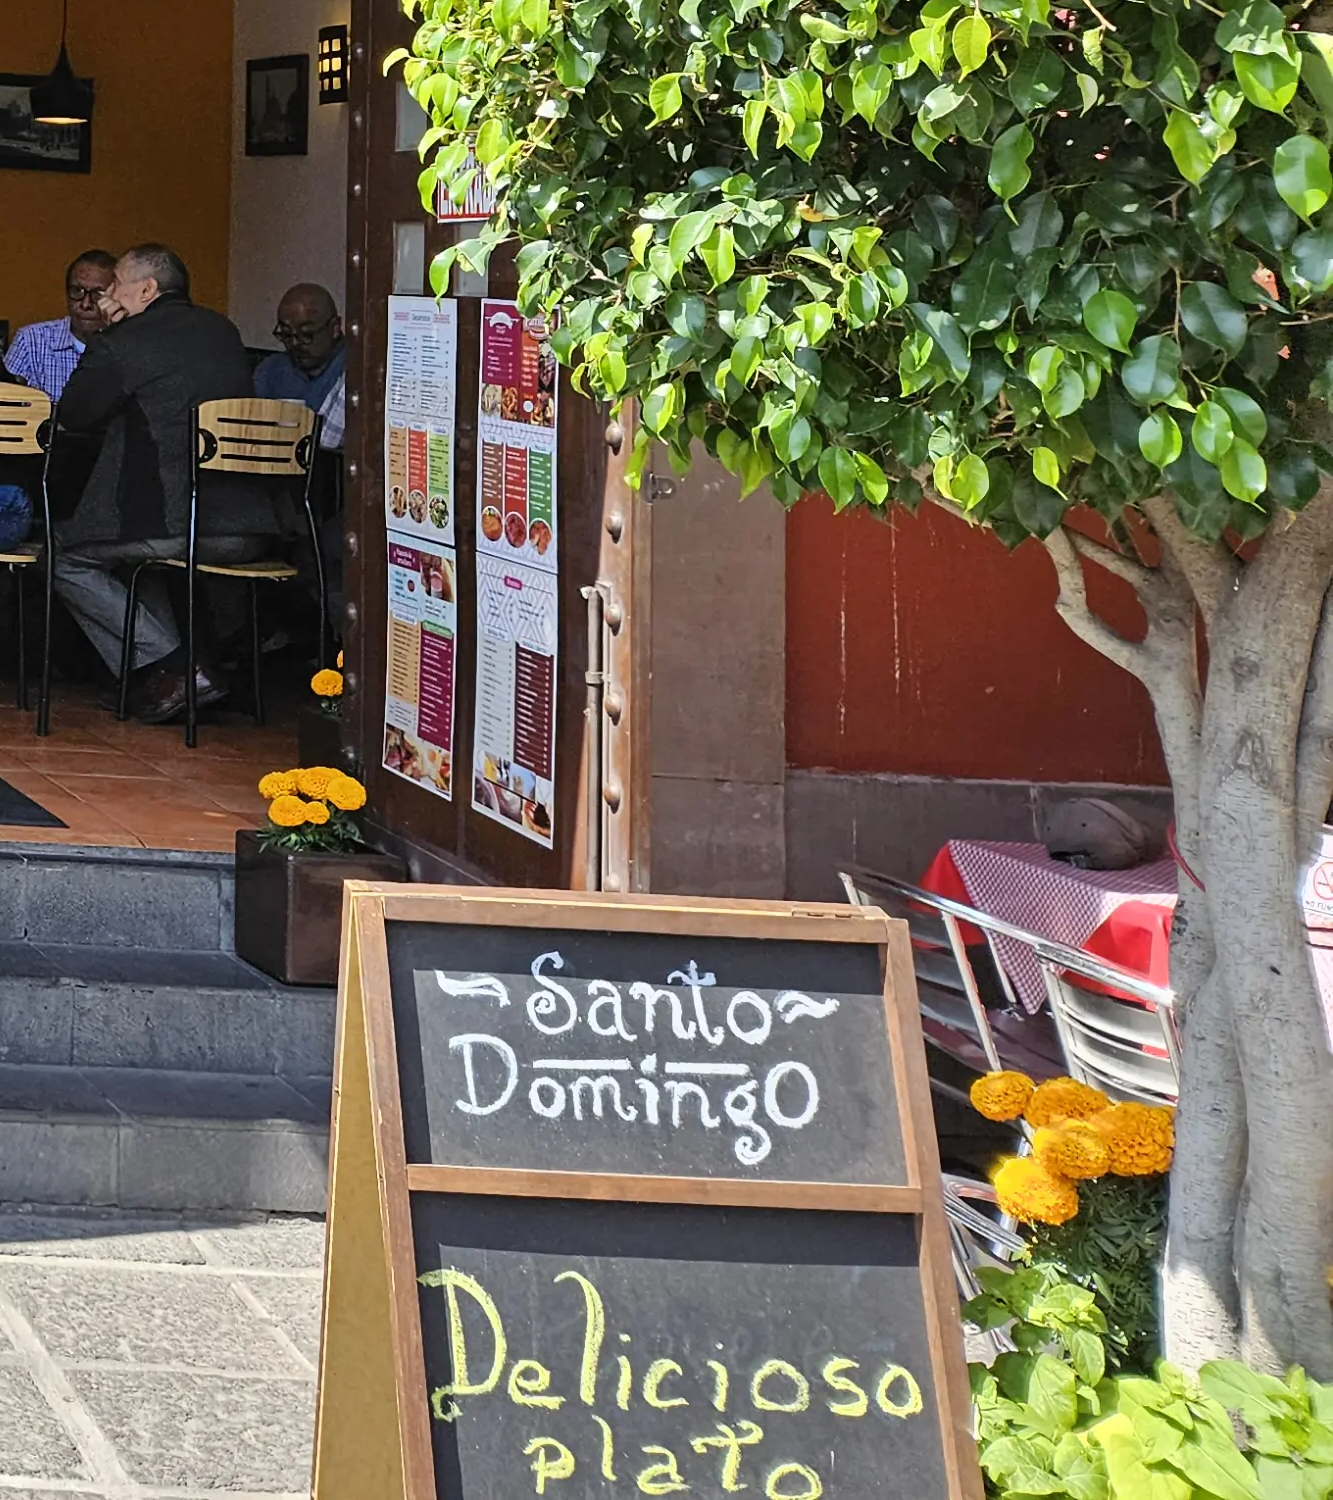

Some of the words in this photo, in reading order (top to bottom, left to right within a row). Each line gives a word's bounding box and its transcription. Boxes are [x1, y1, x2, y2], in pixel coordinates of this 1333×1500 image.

[524, 950, 773, 1046] Santo
[416, 1268, 924, 1422] Delicioso
[522, 1416, 824, 1500] plato
